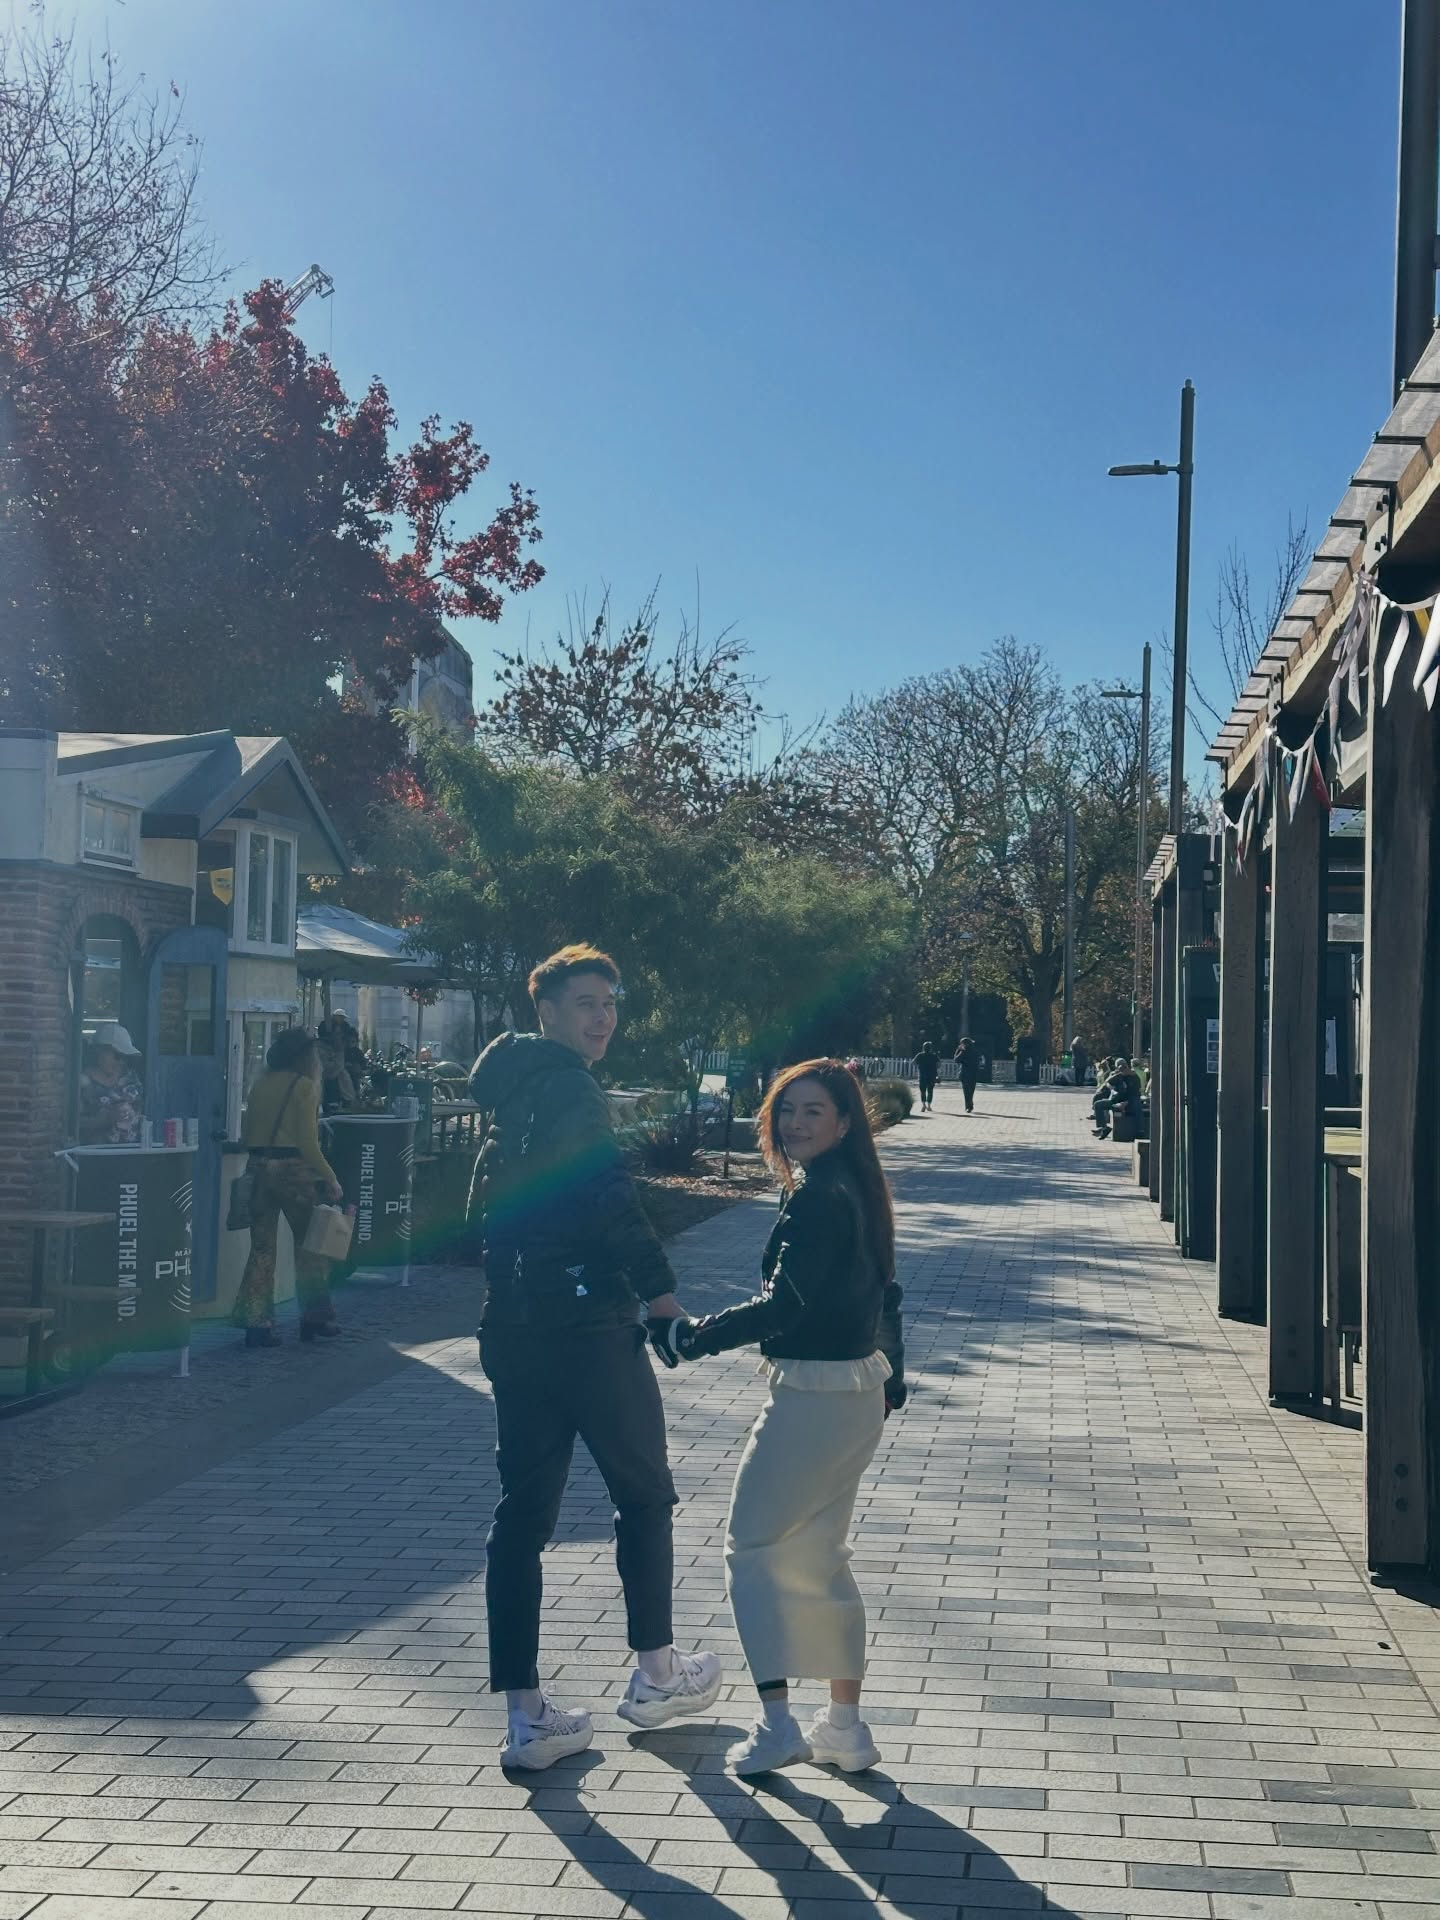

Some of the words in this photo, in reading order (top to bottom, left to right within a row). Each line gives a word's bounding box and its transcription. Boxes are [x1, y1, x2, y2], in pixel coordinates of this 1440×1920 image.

[361, 1144, 375, 1182] PHUEL
[119, 1184, 138, 1236] PHUEL
[360, 1184, 374, 1207] THE
[358, 1209, 373, 1244] MIND.
[119, 1239, 137, 1270] THE
[118, 1274, 137, 1322] MND.
